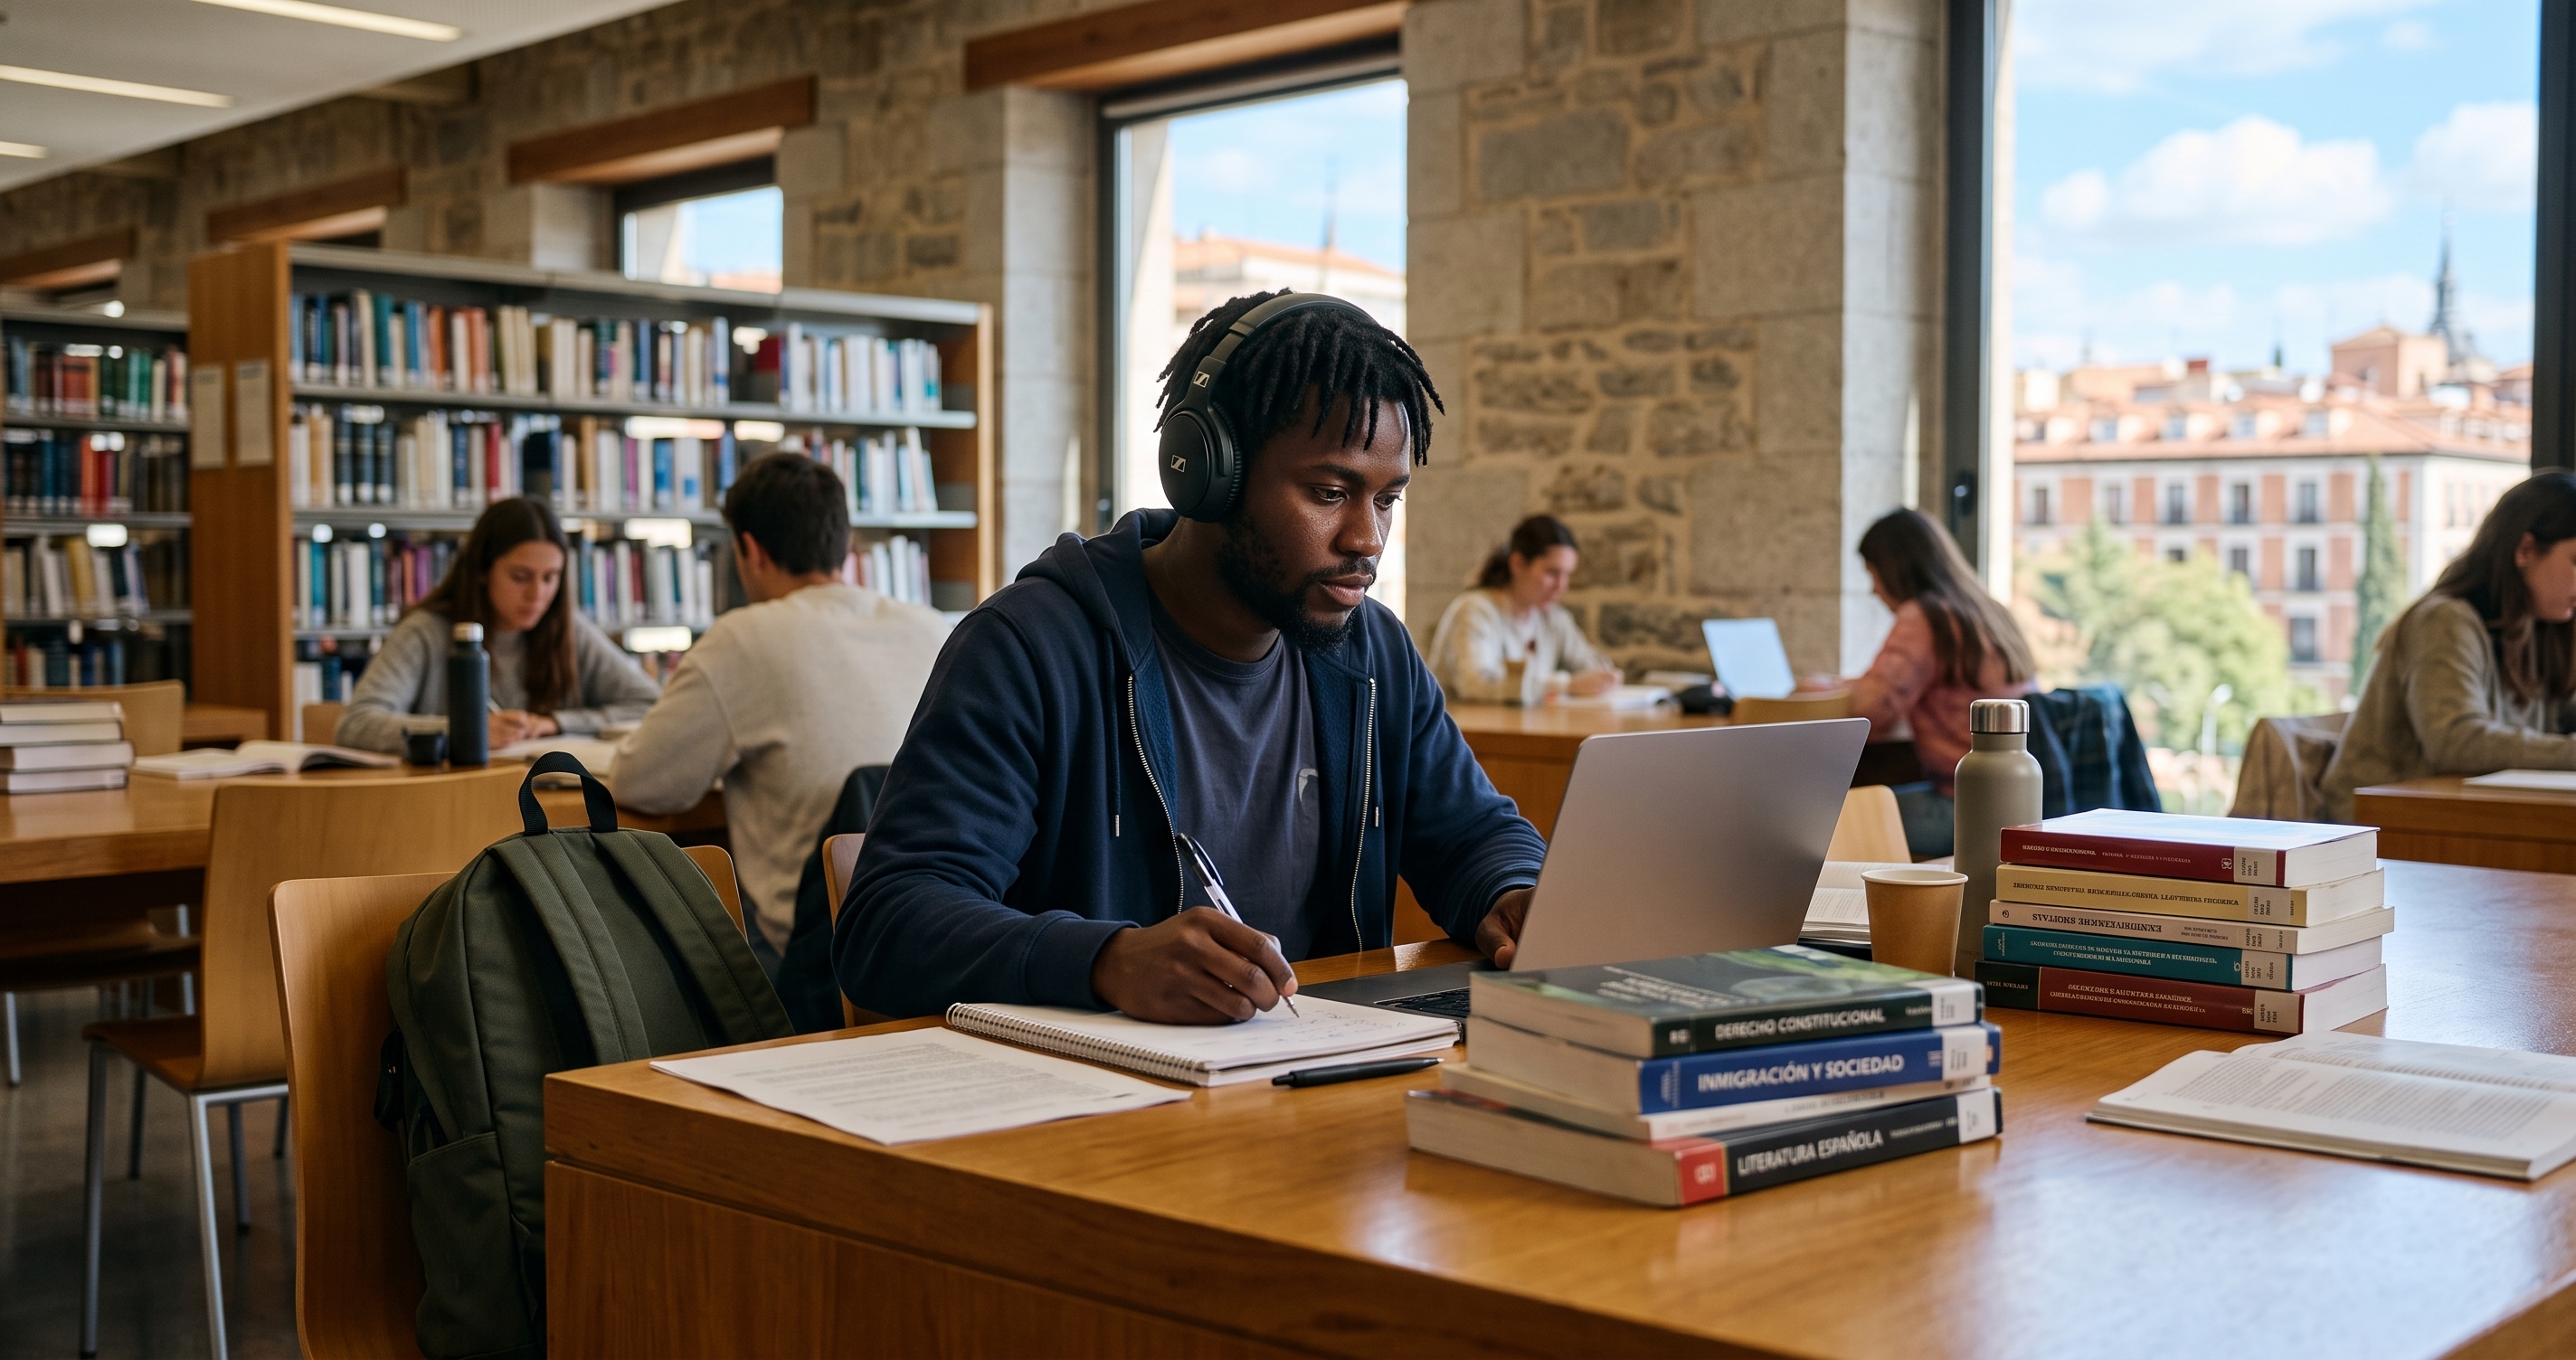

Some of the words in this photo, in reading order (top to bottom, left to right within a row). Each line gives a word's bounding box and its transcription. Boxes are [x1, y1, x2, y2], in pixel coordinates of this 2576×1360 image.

[1715, 1018, 1776, 1040] DERECHO
[1777, 1008, 1886, 1034] CONSTITUCIONAL
[1698, 1061, 1809, 1092] INMIGRACIÓN
[1810, 1062, 1823, 1080] Y
[1825, 1053, 1905, 1080] SOCIEDAD
[1738, 1142, 1816, 1176] LITERATURA
[1818, 1129, 1884, 1159] ESPAÑOLA
